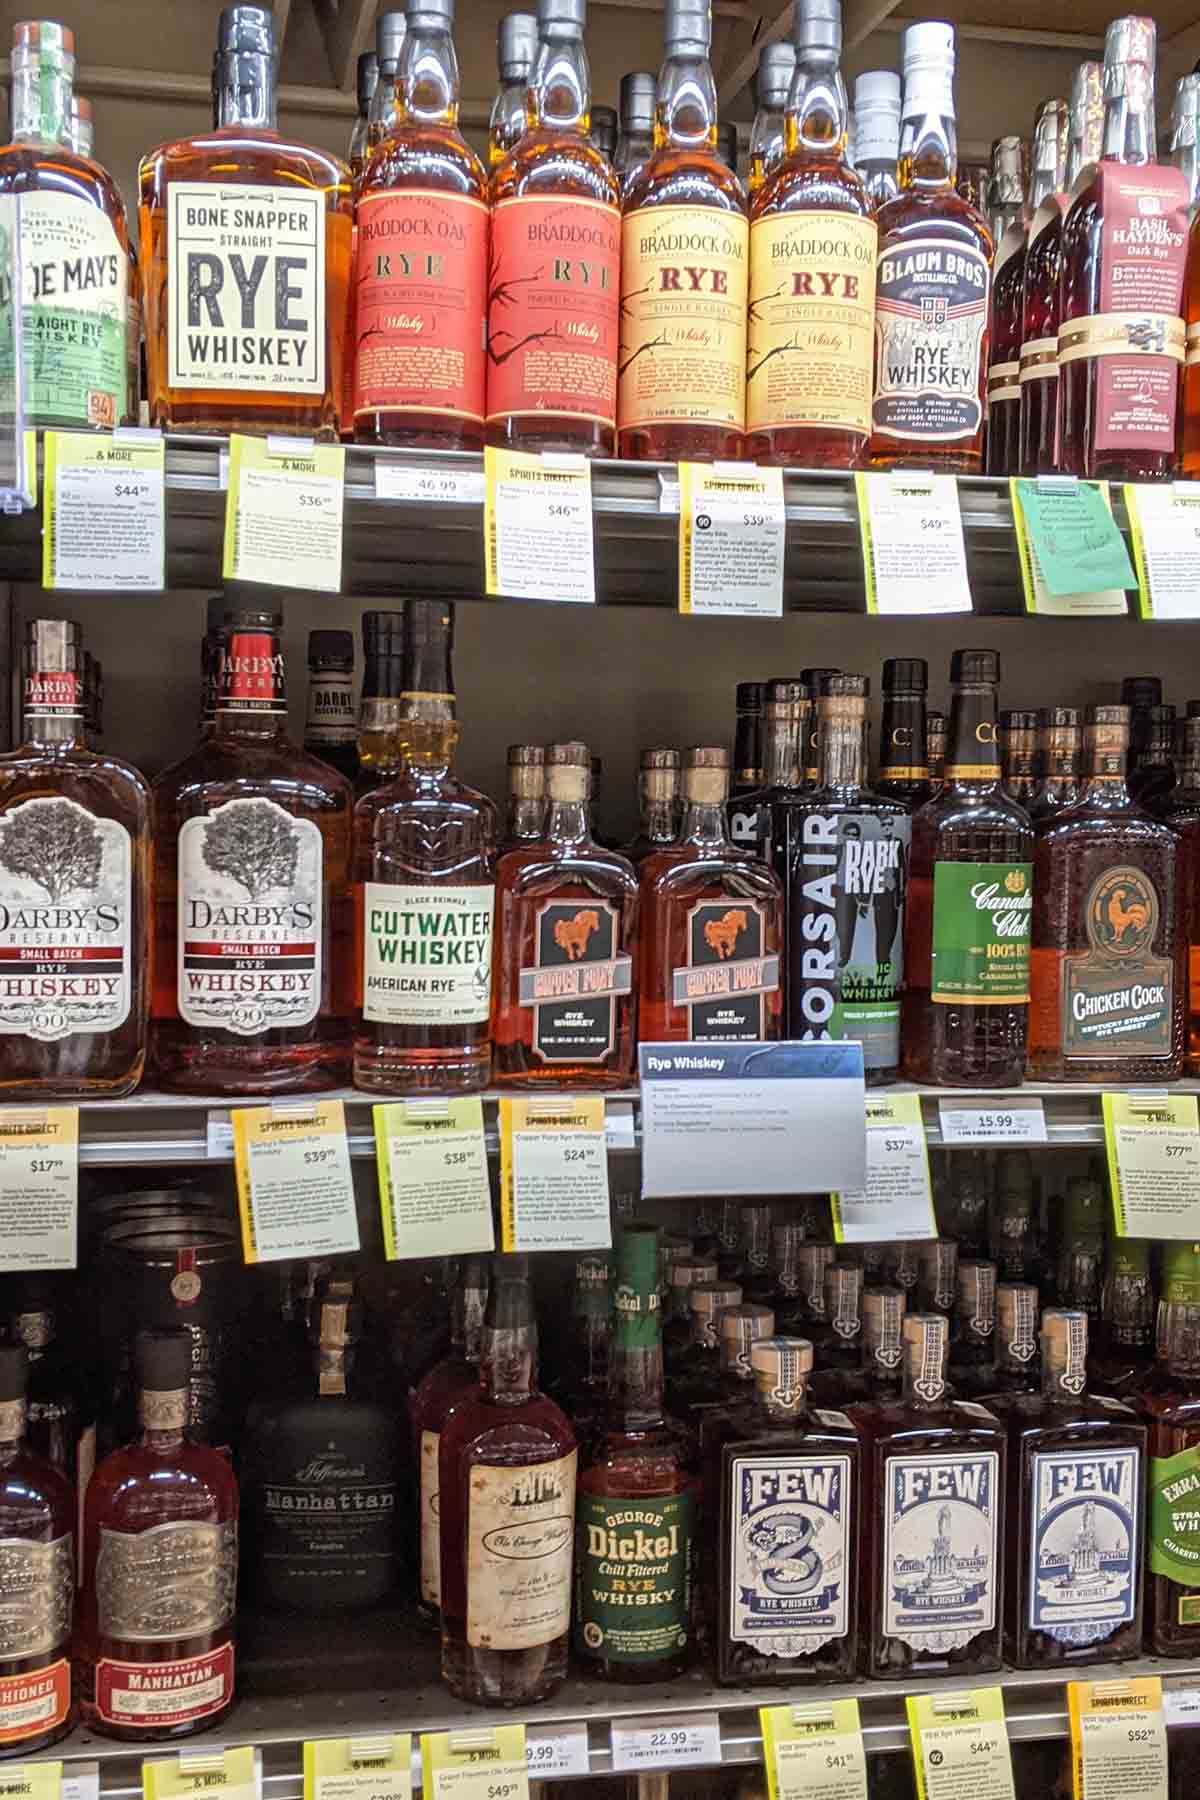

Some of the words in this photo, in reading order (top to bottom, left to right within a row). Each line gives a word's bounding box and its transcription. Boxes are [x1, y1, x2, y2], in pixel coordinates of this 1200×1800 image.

[187, 208, 228, 227] BONE
[234, 210, 308, 231] SNAPPER
[1129, 218, 1170, 234] BASIL
[220, 234, 273, 248] STRAIGHT
[640, 234, 718, 254] BRADDOCK
[1112, 231, 1185, 248] HAYDEN'S
[771, 240, 851, 258] BRADDOCK
[1128, 246, 1150, 257] Dark
[63, 254, 118, 293] MAY'S
[881, 252, 942, 284] BLAUM
[659, 266, 728, 295] RYE
[792, 272, 859, 300] RYE
[187, 252, 308, 332] RYE
[188, 334, 308, 366] WHISKEY
[914, 348, 949, 365] RYE
[888, 366, 971, 388] WHISKEY
[107, 451, 132, 462] MORE
[292, 462, 316, 473] MORE
[508, 468, 542, 480] SPIRITS
[846, 840, 900, 868] DARK
[844, 868, 885, 894] RYE
[186, 900, 313, 928] DARBY'S
[370, 910, 490, 937] CUTWATER
[20, 949, 50, 960] SMALL
[54, 949, 82, 959] BATCH
[221, 946, 250, 954] SMALL
[252, 946, 280, 954] BATCH
[378, 938, 487, 965] WHISKEY
[34, 964, 68, 974] RYE
[236, 960, 265, 969] RYE
[187, 974, 313, 992] WHISKEY
[368, 976, 427, 993] AMERICAN
[431, 979, 456, 992] RYE
[841, 987, 895, 1000] WHISKEY
[1072, 986, 1130, 1021] CHICKEN
[1131, 984, 1164, 1010] COCK
[234, 1008, 262, 1022] 90
[648, 1056, 672, 1071] Rye
[674, 1056, 725, 1072] Whiskey
[978, 1116, 1012, 1127] 15.99
[751, 1468, 834, 1506] FEW
[903, 1464, 982, 1502] FEW
[1050, 1460, 1124, 1499] FEW
[605, 1512, 664, 1528] GEORGE
[587, 1524, 680, 1562] Dickel
[1164, 1538, 1200, 1560] CHARRED
[611, 1580, 656, 1592] RYE
[592, 1590, 675, 1606] WHISKY
[128, 1666, 213, 1690] MANHATTAN
[650, 1731, 687, 1746] 22.99
[204, 1774, 227, 1787] MORE
